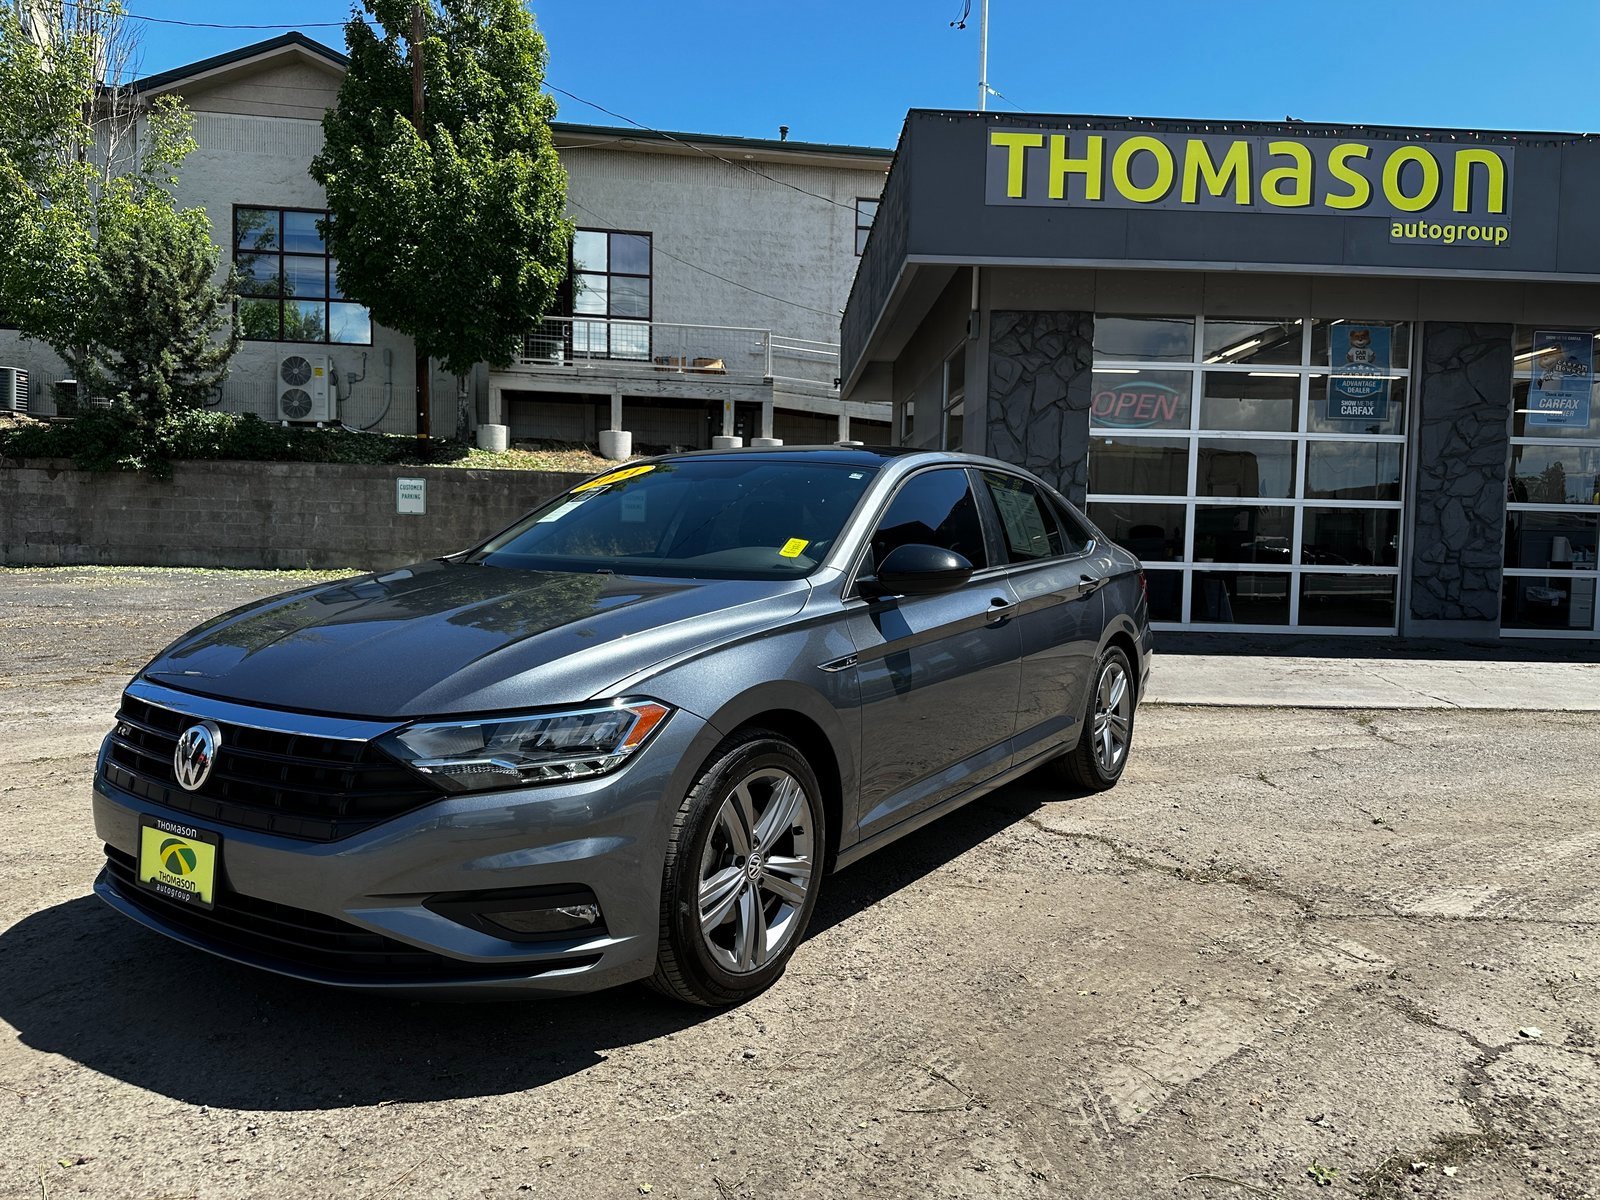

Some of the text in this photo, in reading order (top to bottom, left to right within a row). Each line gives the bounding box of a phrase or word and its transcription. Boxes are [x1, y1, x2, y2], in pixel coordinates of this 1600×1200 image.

[1391, 221, 1508, 245] autogroup
[1091, 391, 1179, 420] OPEN
[1341, 406, 1375, 415] CARFAX
[1538, 398, 1579, 409] CARFAX
[156, 883, 191, 902] autogroup
